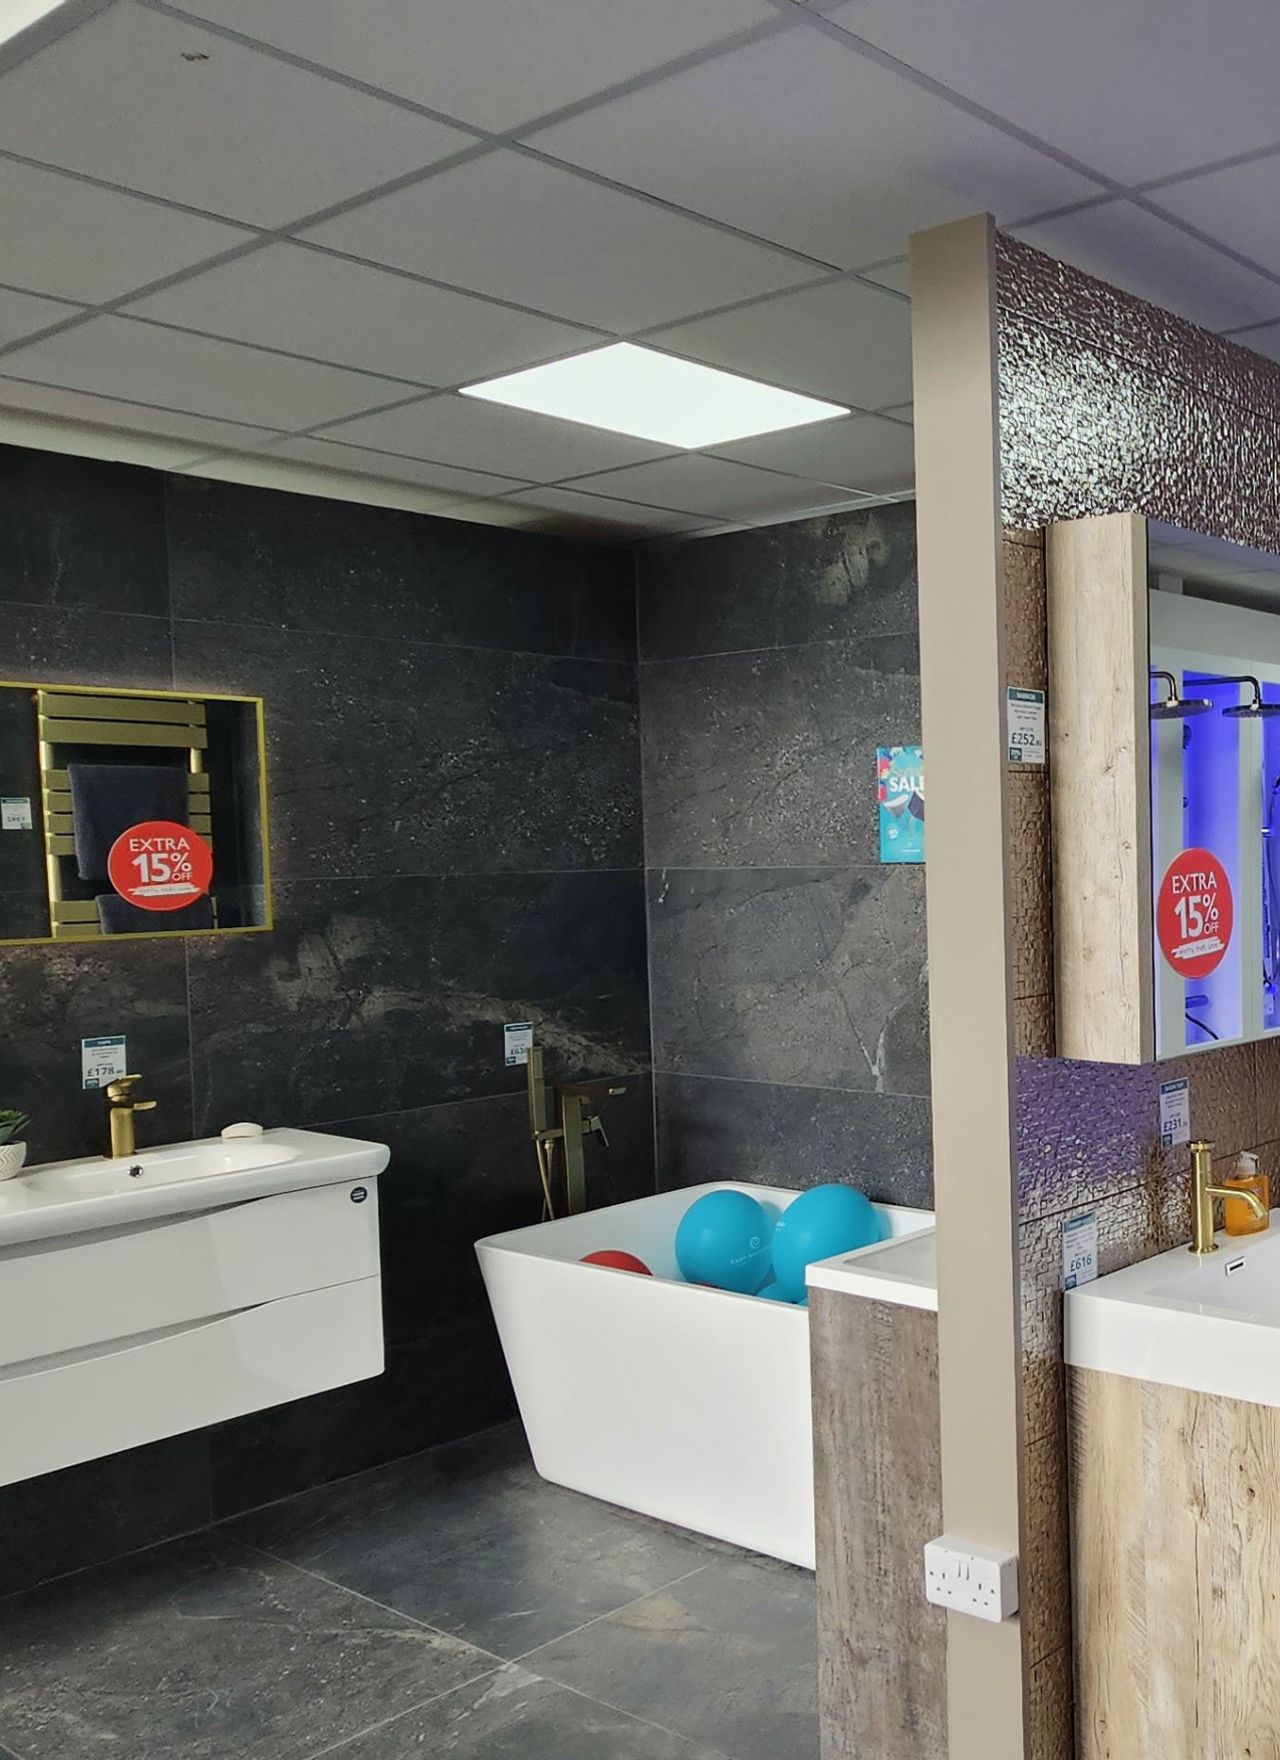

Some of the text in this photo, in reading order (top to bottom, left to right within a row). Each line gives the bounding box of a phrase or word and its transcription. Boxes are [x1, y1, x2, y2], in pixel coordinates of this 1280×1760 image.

[129, 837, 190, 852] EXTRA
[131, 852, 192, 883] 15%
[171, 872, 193, 881] OFF
[1172, 871, 1217, 894] EXTRA
[1174, 892, 1219, 939] 15%
[1203, 922, 1219, 935] OFF
[1070, 1254, 1092, 1272] £616
